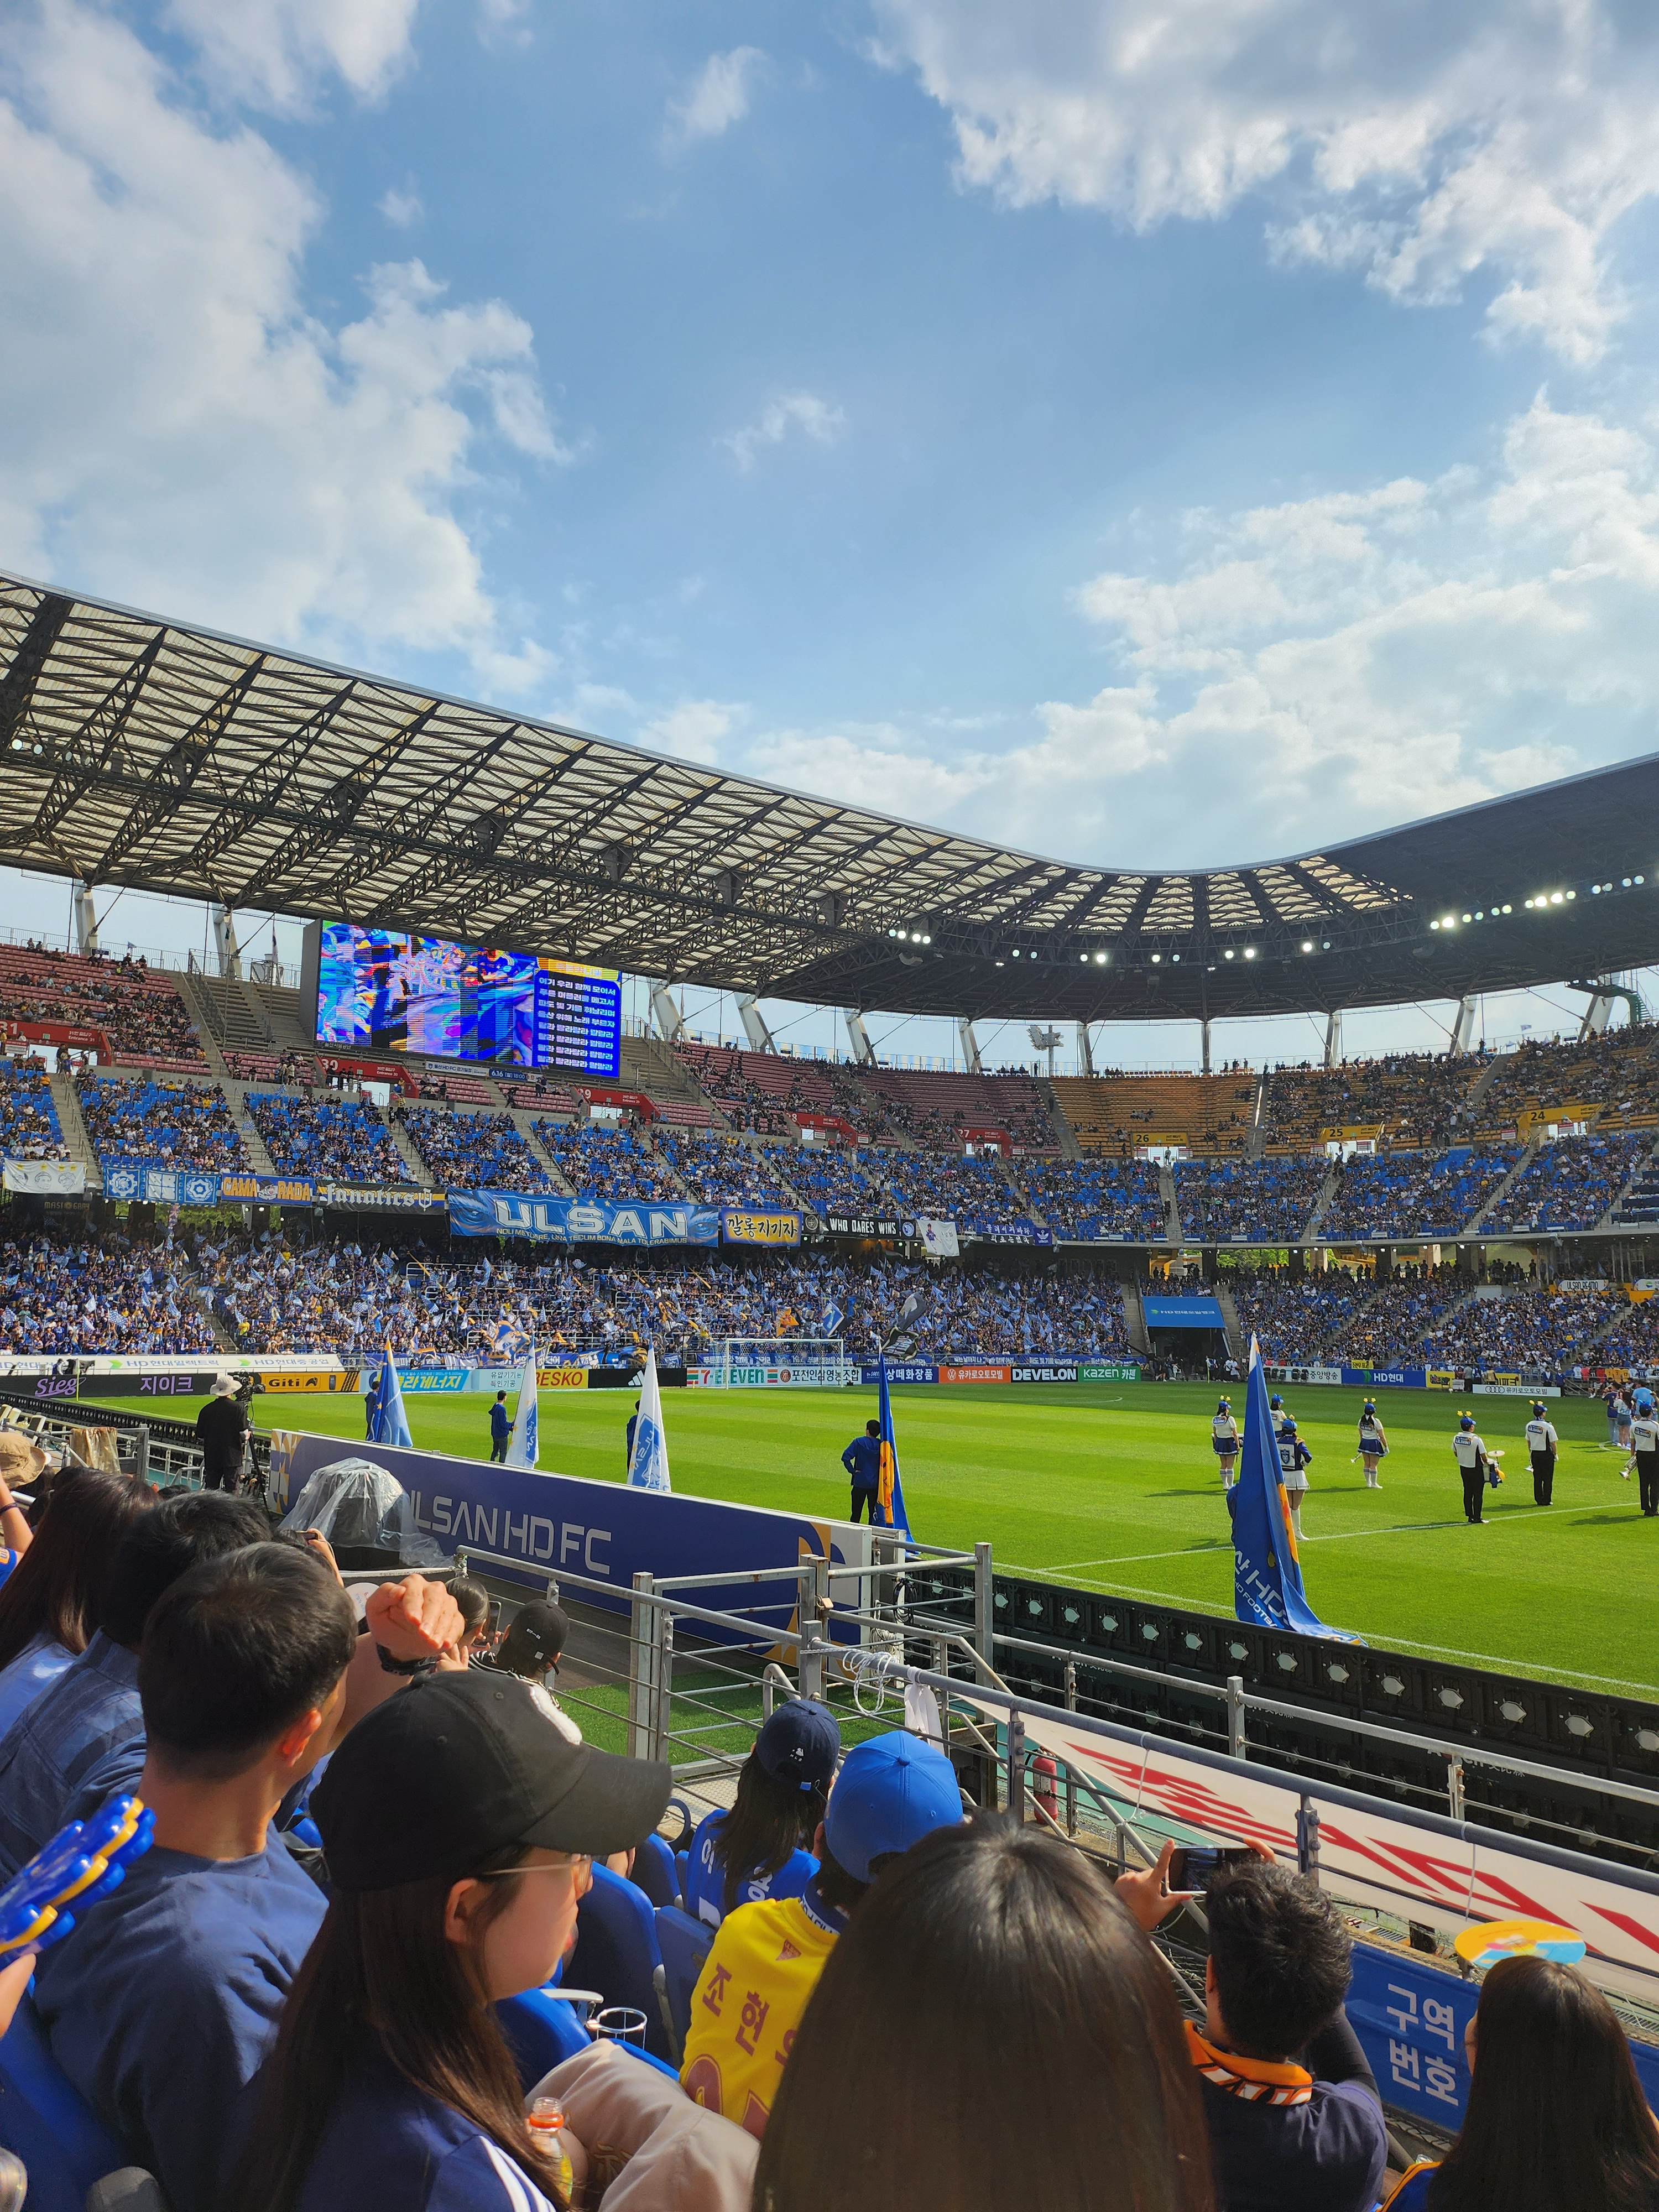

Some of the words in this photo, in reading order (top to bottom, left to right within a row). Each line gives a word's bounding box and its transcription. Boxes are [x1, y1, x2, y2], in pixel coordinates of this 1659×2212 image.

[539, 977, 555, 986] 여기
[557, 979, 573, 989] 우리
[592, 986, 615, 995] 모여서
[574, 1016, 589, 1024] 노래
[1531, 1111, 1545, 1121] 24
[1136, 1134, 1149, 1142] 26
[1329, 1128, 1343, 1137] 25
[223, 1177, 257, 1197] CAMA
[277, 1181, 311, 1201] RADA
[494, 1199, 688, 1239] ULSAN
[830, 1218, 848, 1232] WHO
[852, 1219, 874, 1234] DARES
[878, 1221, 896, 1234] WINS
[792, 1369, 859, 1382] 포천인삼영농조합
[886, 1368, 933, 1381] 상떼화장품
[958, 1370, 1003, 1380] 유카로오토모빌
[1012, 1368, 1076, 1381] DEVELON
[1121, 1369, 1136, 1380] 카젠
[34, 1376, 86, 1397] Sieg
[140, 1375, 194, 1395] 지이크
[269, 1379, 299, 1387] Giti
[1506, 1387, 1547, 1395] 유카로오토모빌
[504, 1510, 554, 1559] HD
[560, 1522, 612, 1574] FC
[1386, 1983, 1454, 2051] 구역
[1389, 2038, 1459, 2106] 번호
